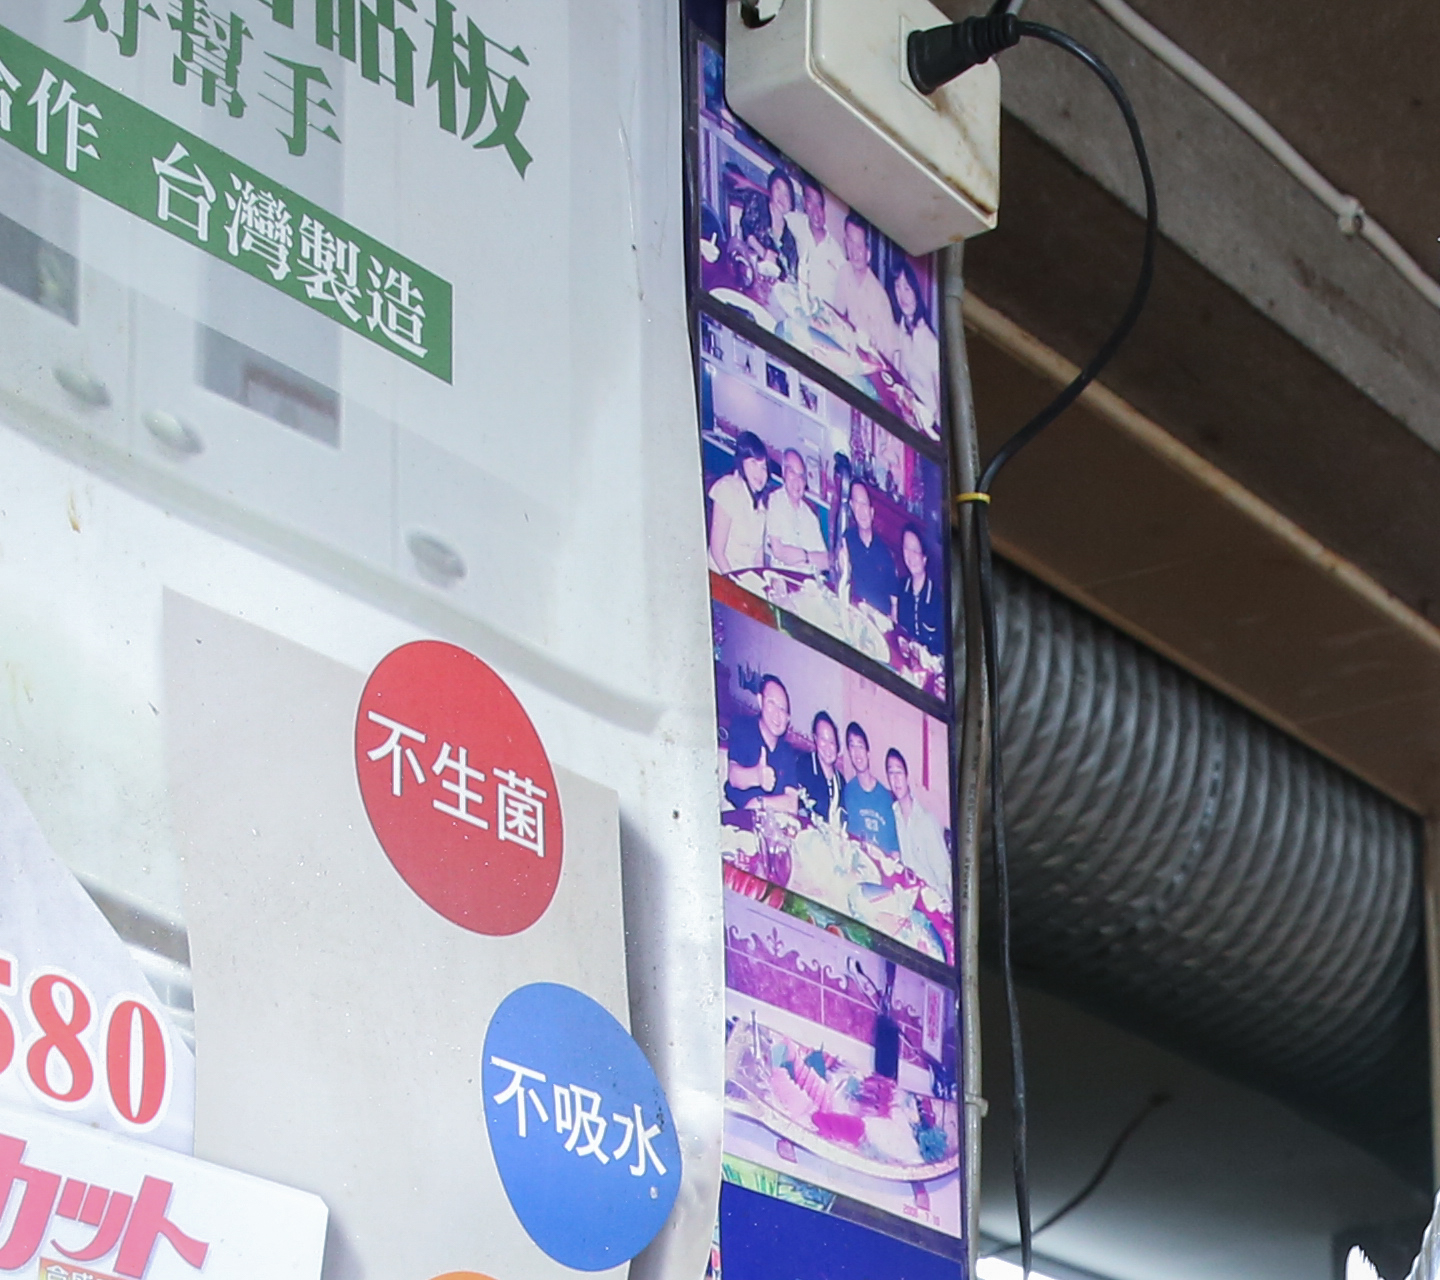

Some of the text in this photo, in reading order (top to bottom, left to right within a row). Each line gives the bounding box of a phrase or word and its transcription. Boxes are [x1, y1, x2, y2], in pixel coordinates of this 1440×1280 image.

[272, 0, 533, 181] 砧板
[152, 142, 429, 358] 台灣製造
[367, 710, 548, 858] 不生菌
[490, 1055, 668, 1178] 不吸水
